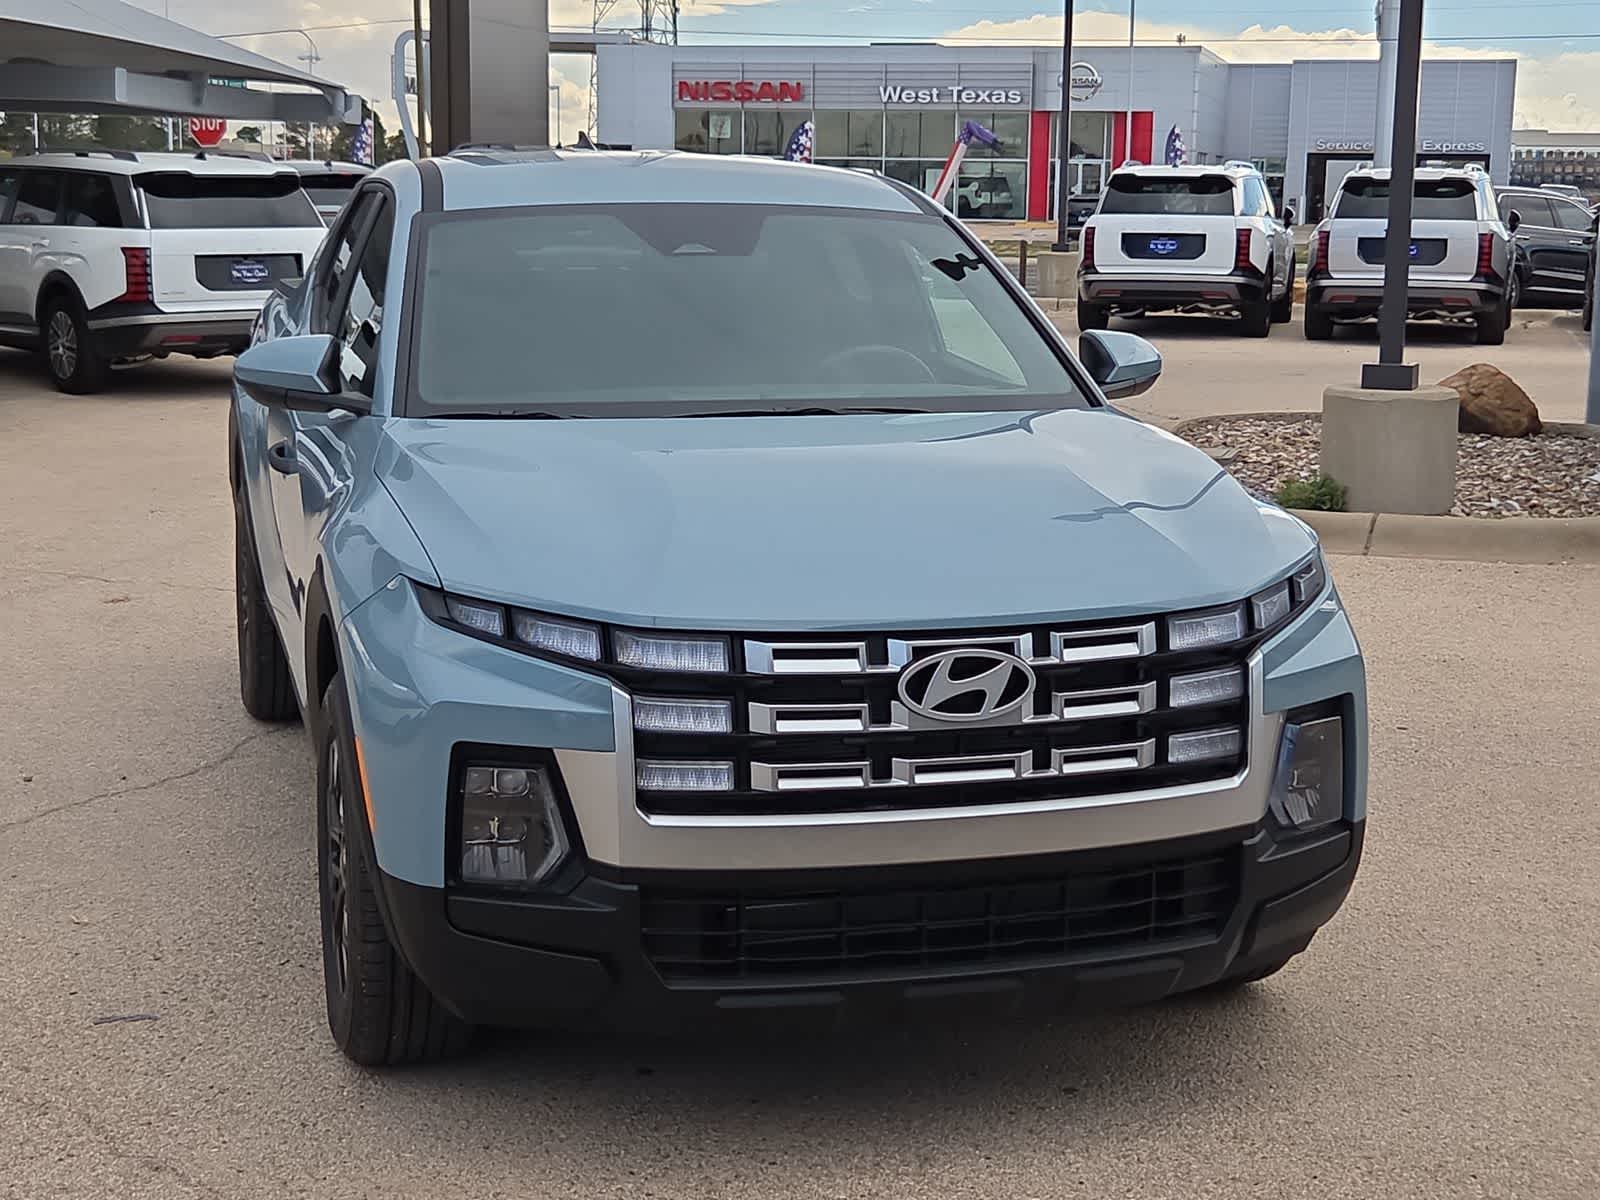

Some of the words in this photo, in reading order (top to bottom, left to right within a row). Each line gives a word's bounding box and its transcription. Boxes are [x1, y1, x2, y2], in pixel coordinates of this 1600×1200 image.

[678, 81, 804, 101] NISSAN
[880, 86, 939, 104] West
[948, 86, 1021, 104] Texas
[191, 117, 222, 131] STOP
[1316, 138, 1373, 151] Service
[1422, 139, 1485, 153] Express
